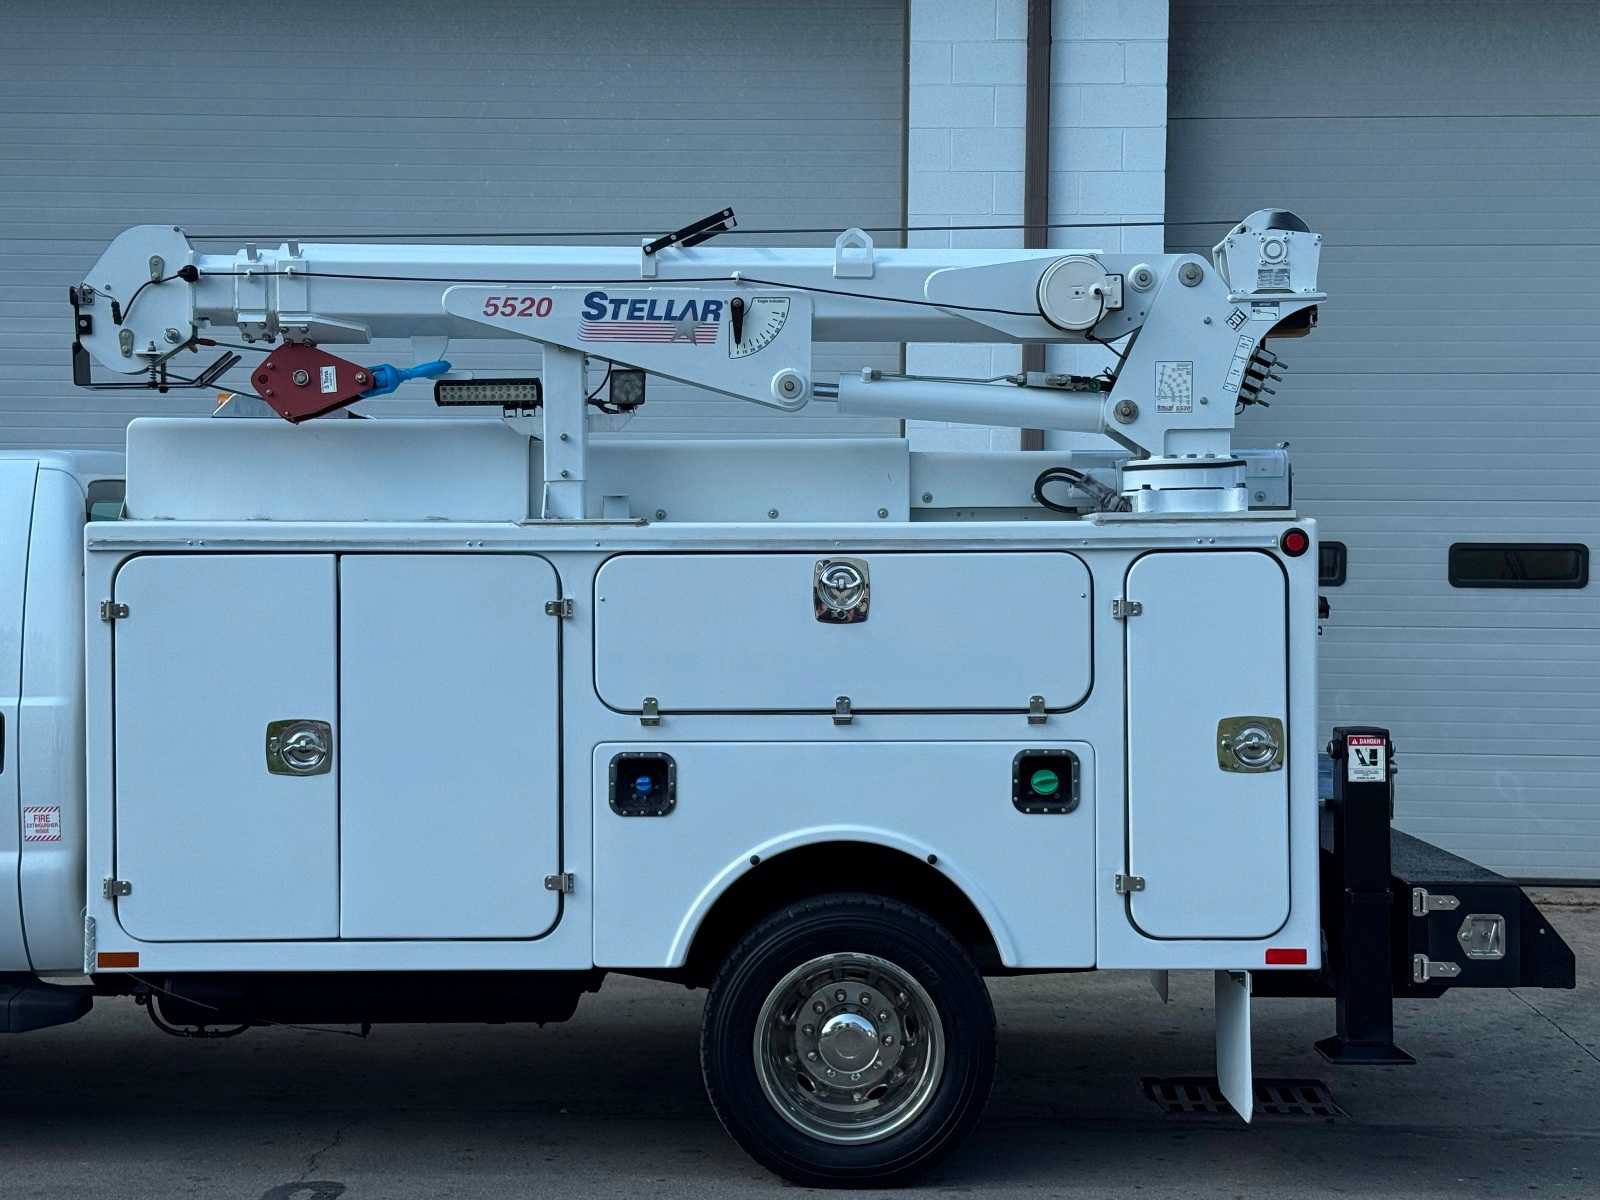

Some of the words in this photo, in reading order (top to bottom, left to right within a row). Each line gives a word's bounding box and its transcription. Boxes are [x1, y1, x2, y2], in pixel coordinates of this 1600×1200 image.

[483, 296, 552, 318] 5520
[581, 291, 723, 321] STELLAR
[1226, 309, 1246, 329] CDT
[33, 814, 50, 823] FIRE
